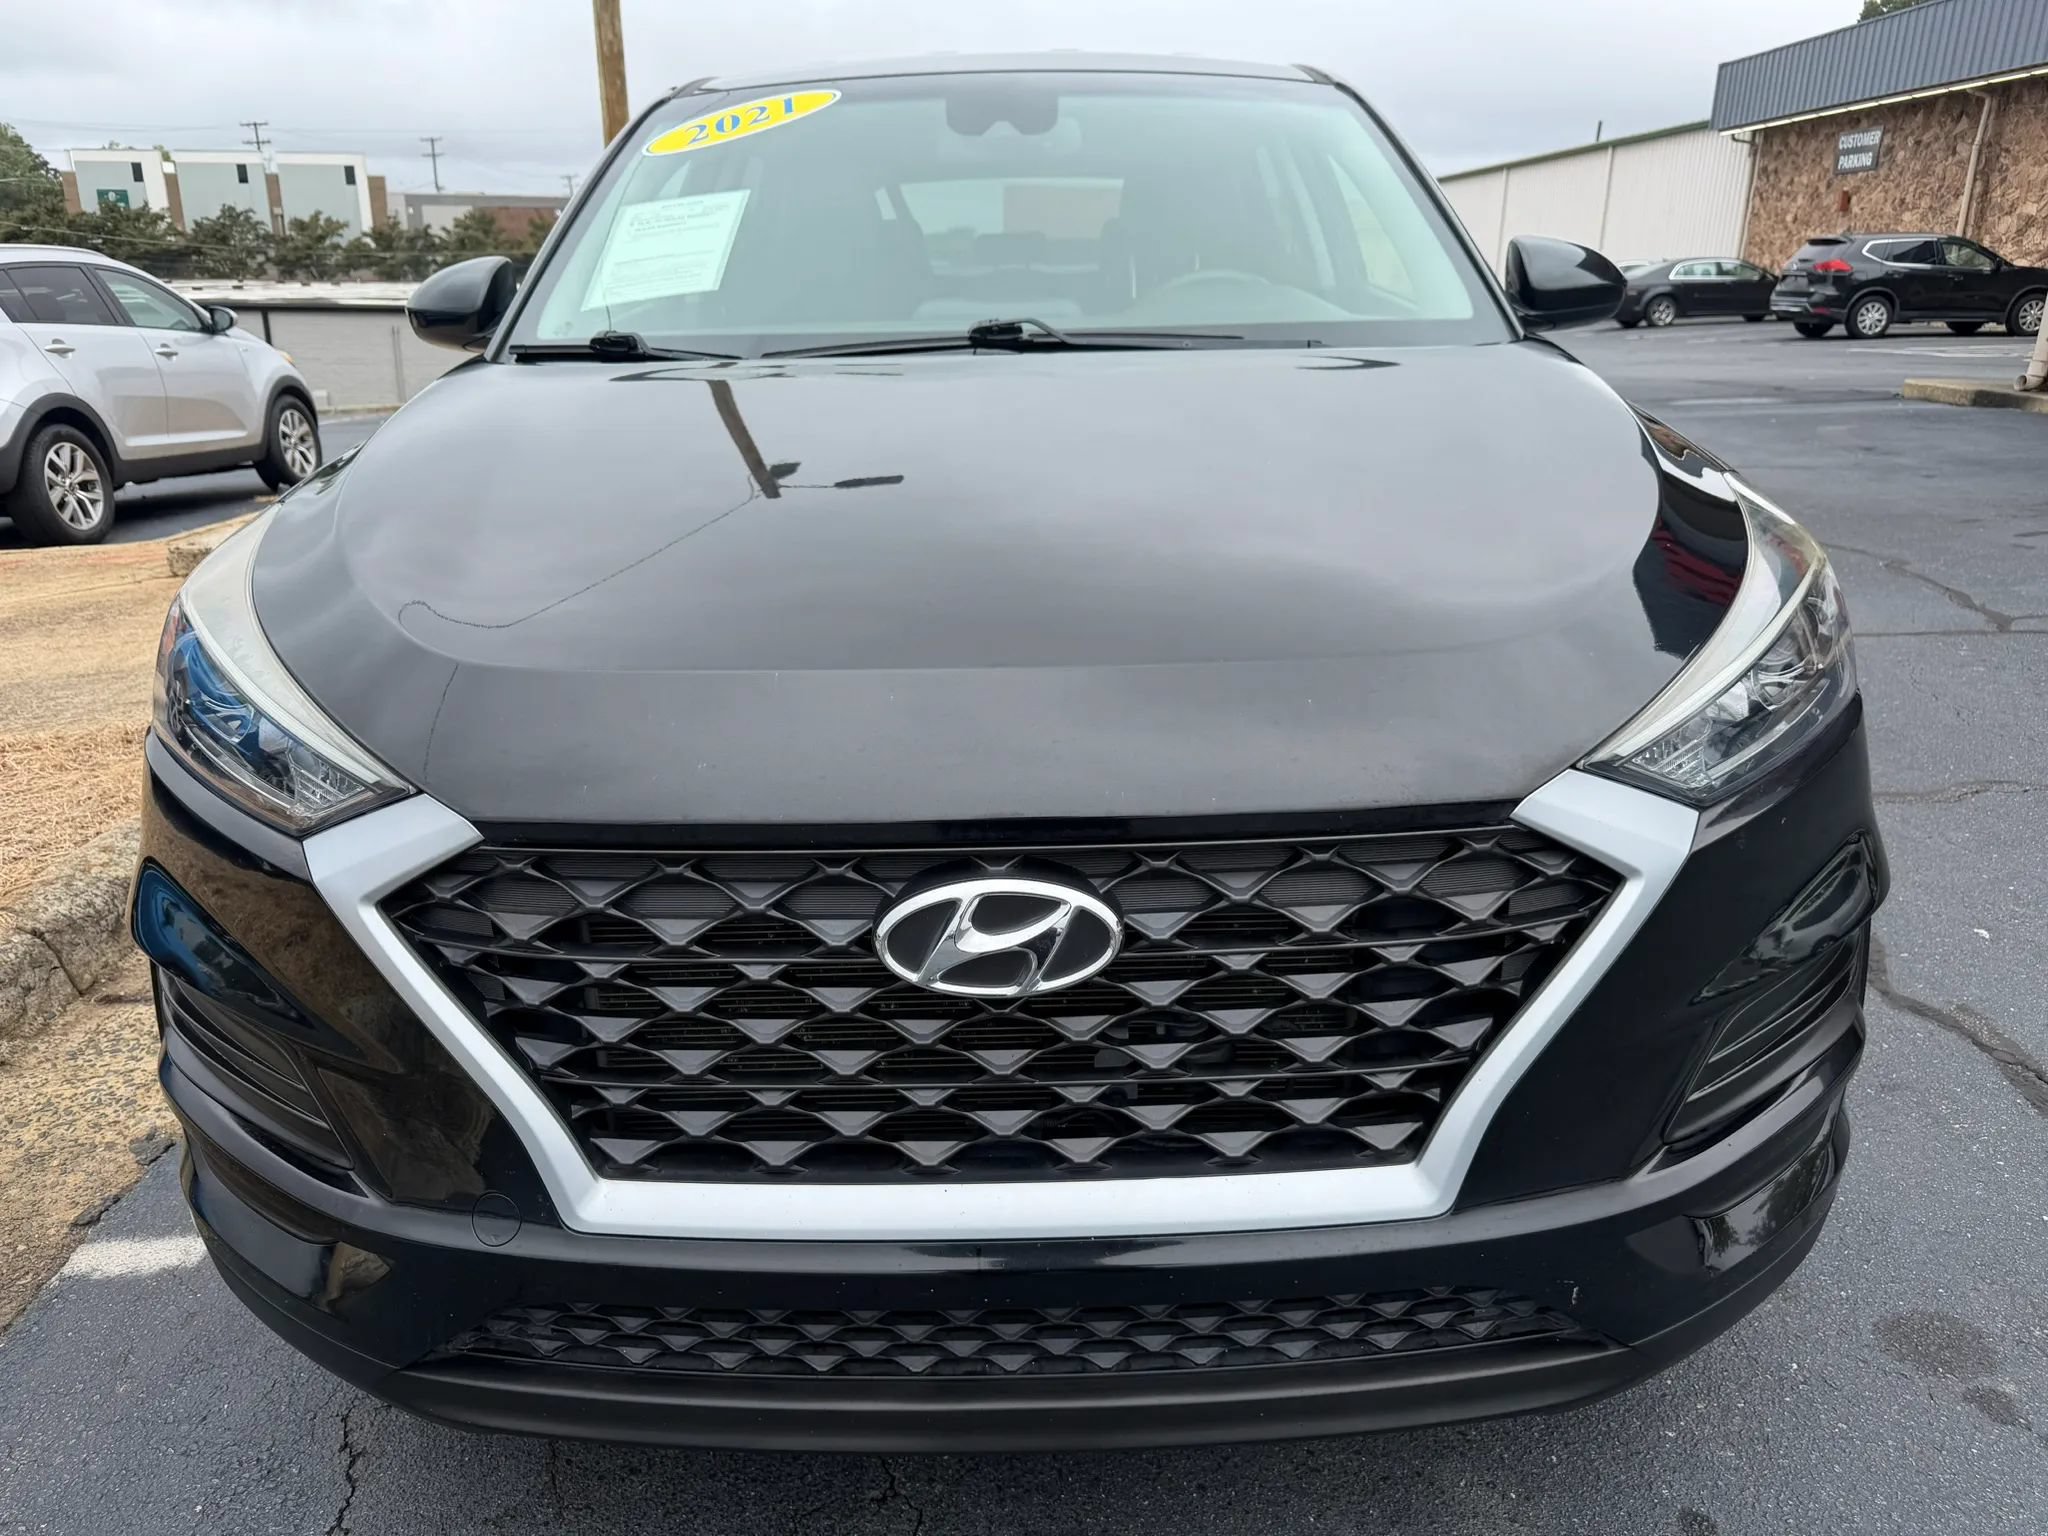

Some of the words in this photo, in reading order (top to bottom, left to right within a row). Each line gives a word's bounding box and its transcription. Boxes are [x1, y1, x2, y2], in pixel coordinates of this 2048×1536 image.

[685, 97, 795, 145] 2021
[1839, 130, 1881, 150] CUSTOMER
[1838, 152, 1873, 170] PARKING
